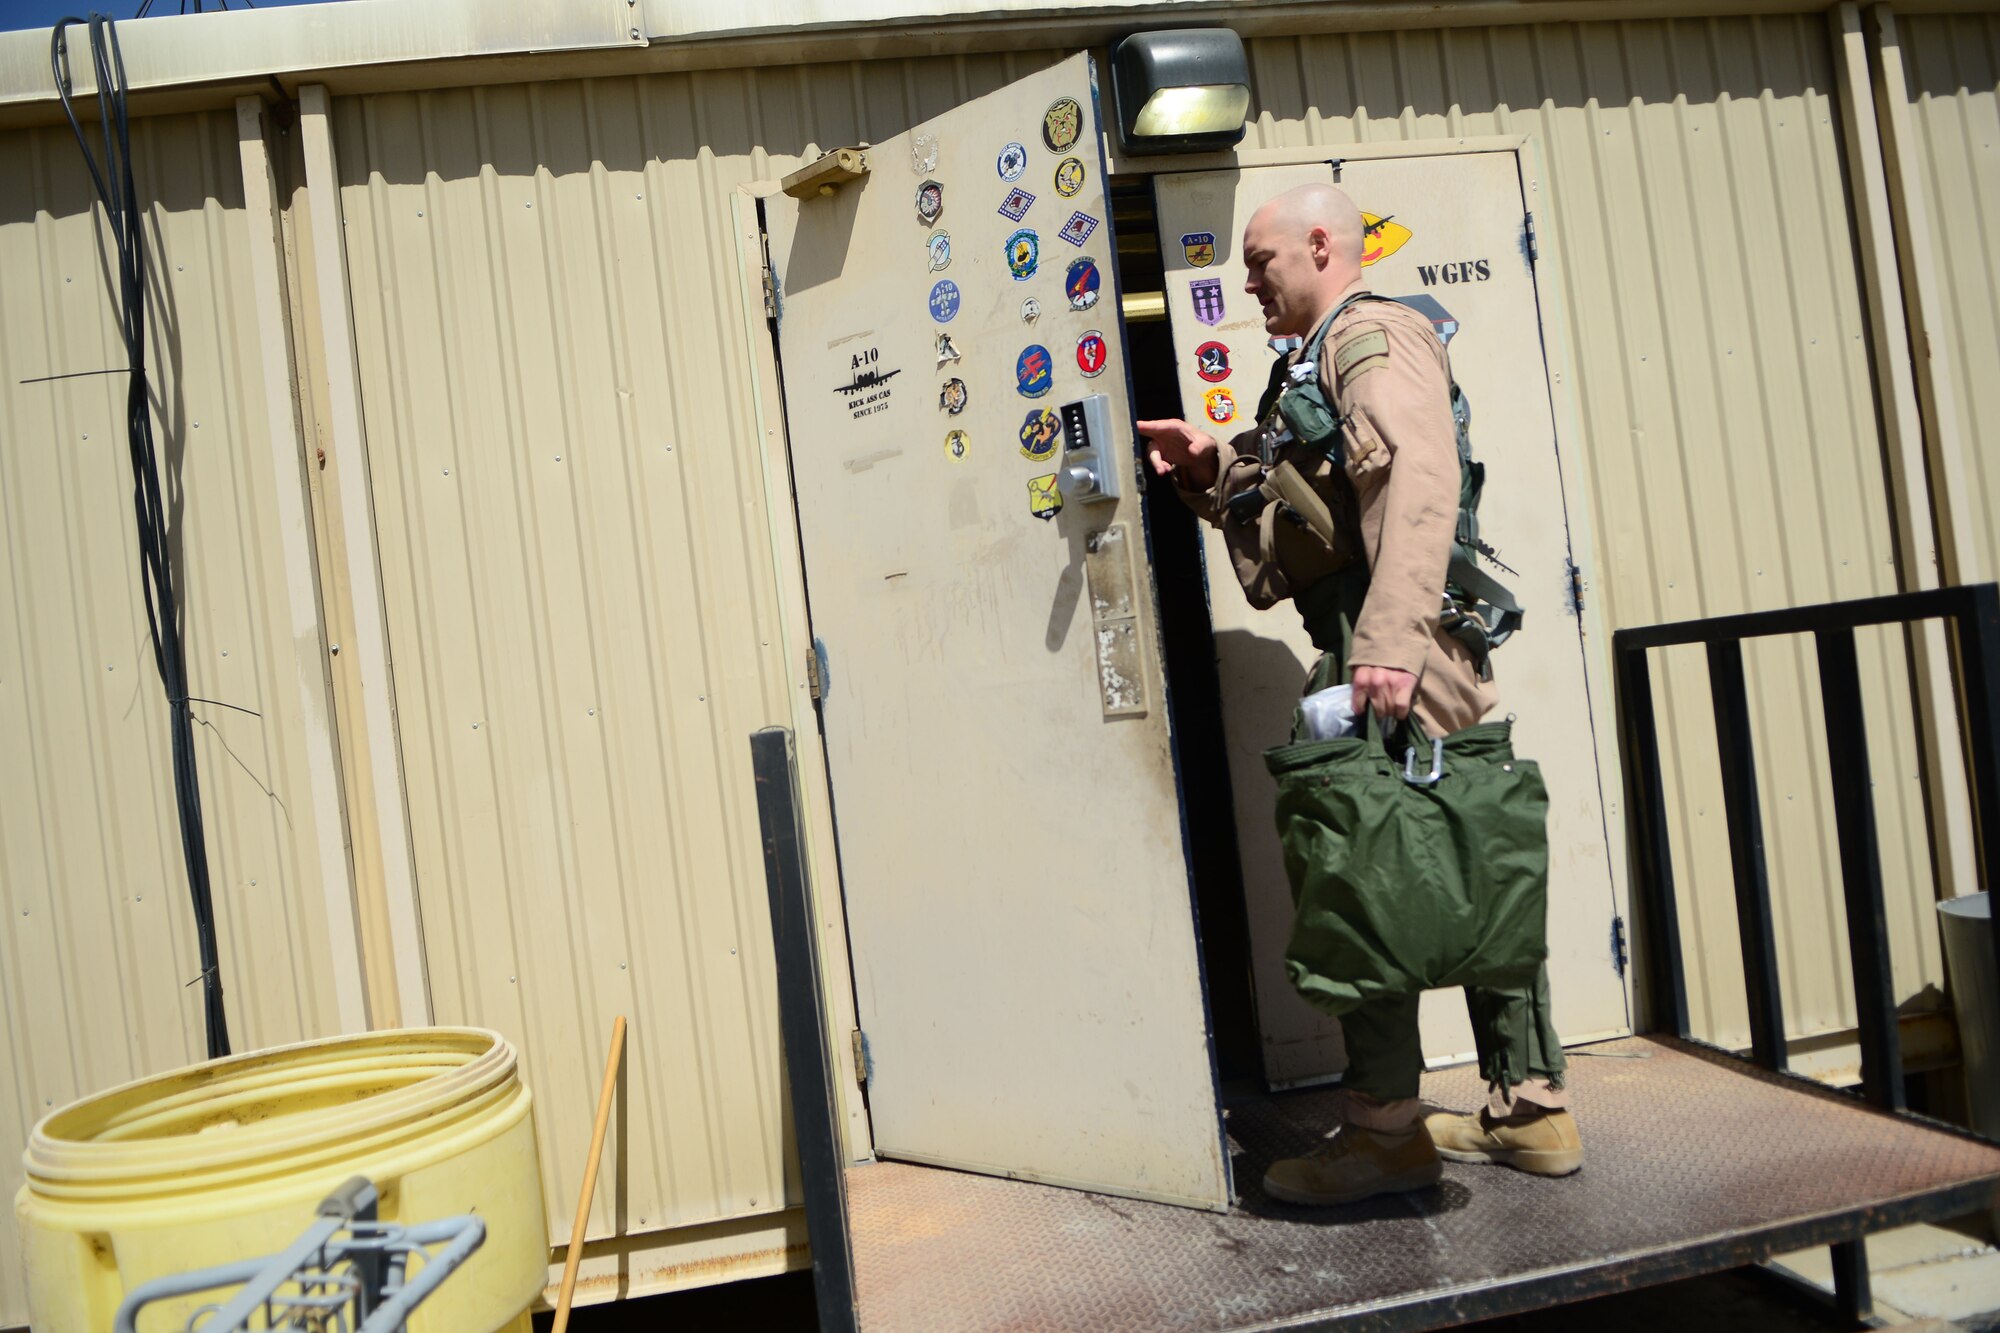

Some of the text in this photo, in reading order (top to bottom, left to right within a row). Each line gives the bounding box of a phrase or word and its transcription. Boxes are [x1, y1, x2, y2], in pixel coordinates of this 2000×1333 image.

[1187, 235, 1209, 245] A-10
[1417, 259, 1490, 286] WGFS
[851, 348, 878, 369] A-10
[848, 390, 890, 409] KICK ASS CAS
[853, 402, 888, 419] SINCE 1975
